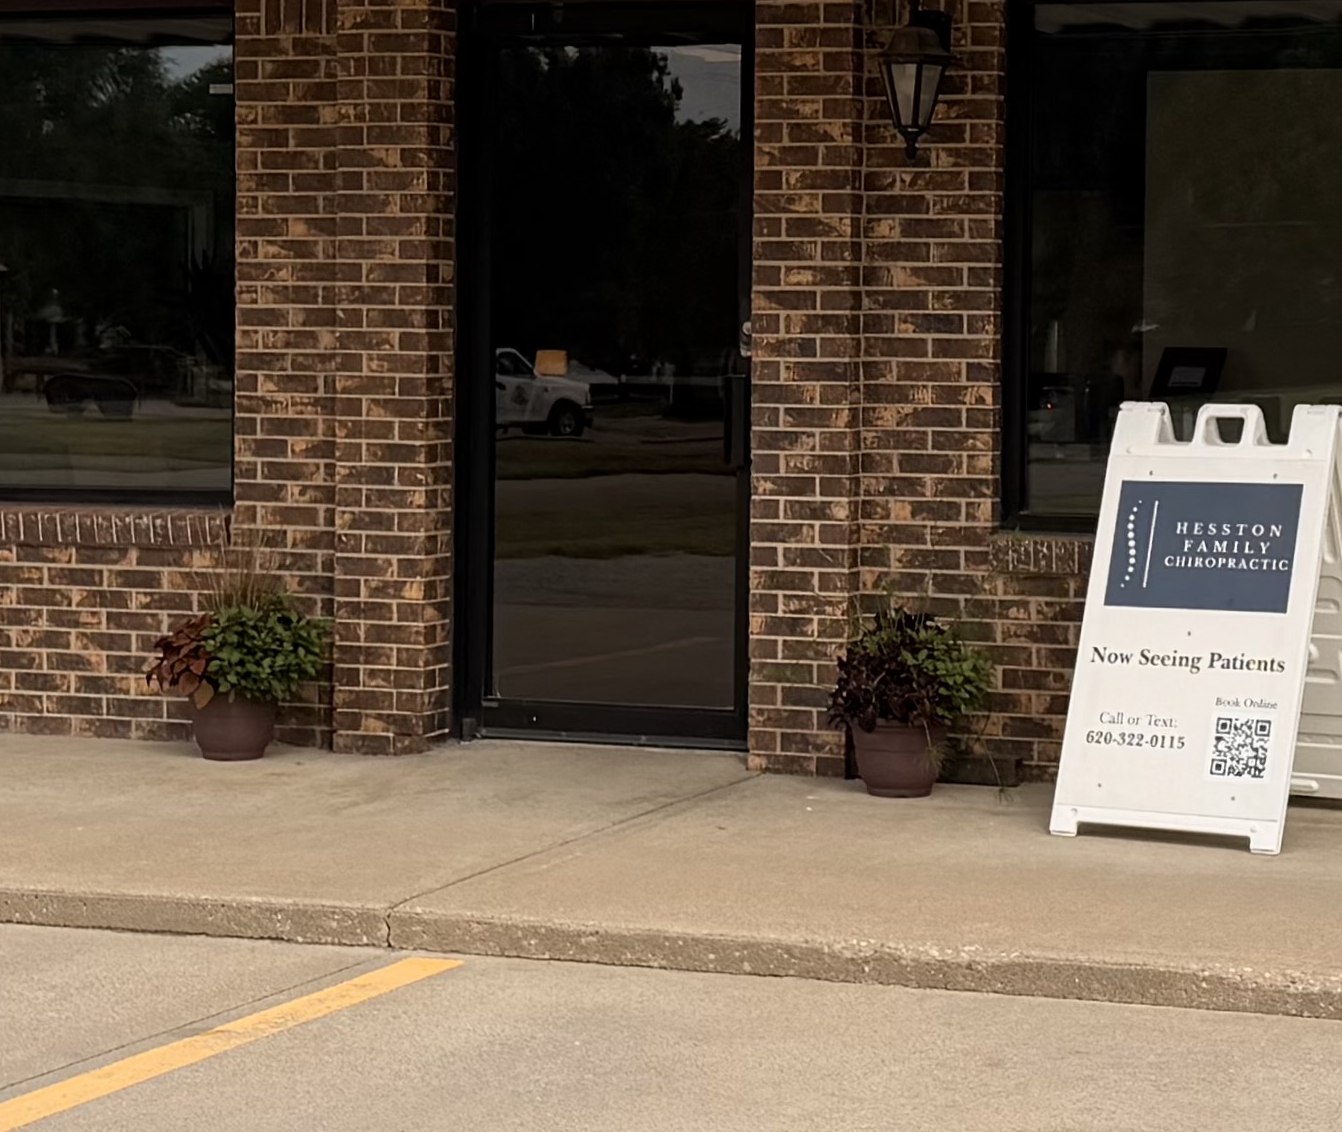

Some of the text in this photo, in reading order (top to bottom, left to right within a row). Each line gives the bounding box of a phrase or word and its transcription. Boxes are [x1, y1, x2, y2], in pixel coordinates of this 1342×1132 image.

[1176, 522, 1283, 537] HESSTON
[1183, 539, 1270, 554] FAMILY
[1164, 556, 1289, 571] CHIROPRACTIC
[1090, 646, 1285, 673] Now Seeing Patients
[1215, 696, 1278, 710] Book Online
[1099, 711, 1178, 728] Call or Text:
[1085, 730, 1185, 749] 620-322-0115
